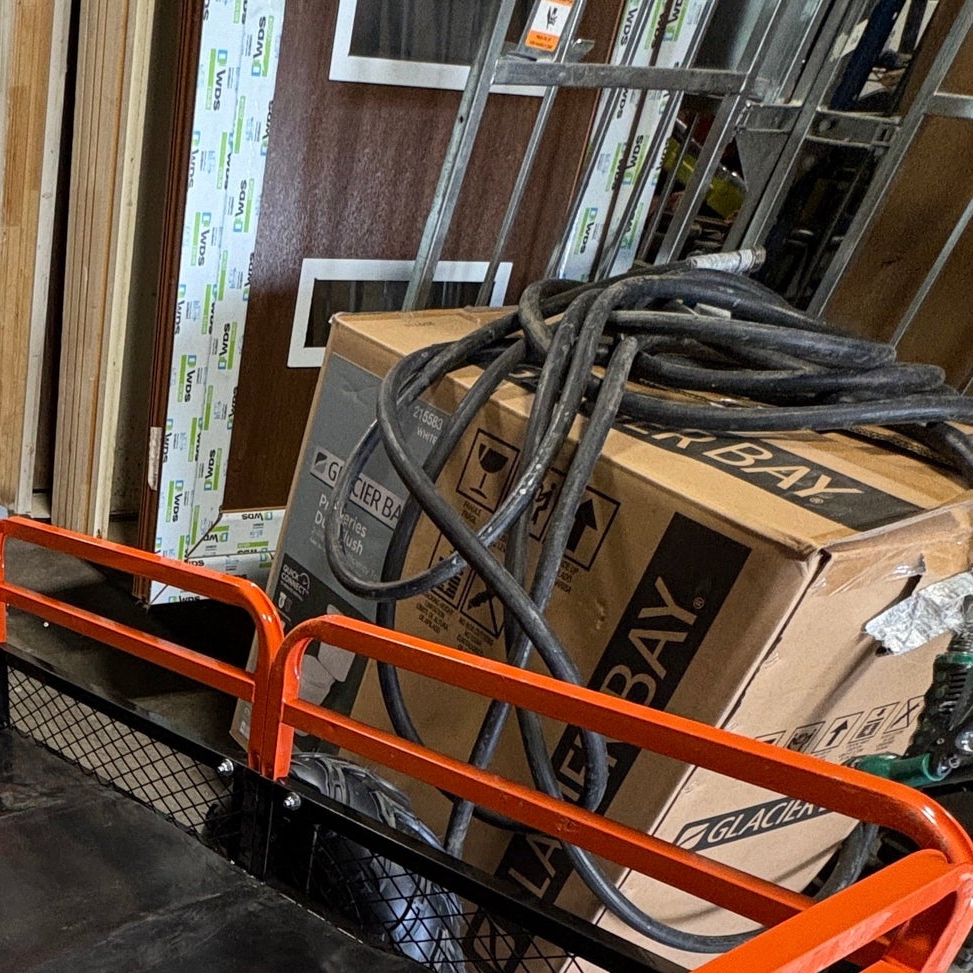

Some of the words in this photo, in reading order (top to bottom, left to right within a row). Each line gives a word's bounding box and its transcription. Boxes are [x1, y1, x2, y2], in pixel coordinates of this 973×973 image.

[253, 16, 266, 58] WDS
[620, 8, 638, 46] WDS
[213, 69, 226, 111] WDS
[235, 179, 247, 217] WDS
[198, 229, 210, 267] WDS
[580, 222, 595, 253] WDS
[219, 323, 230, 356] WDS
[184, 370, 195, 402] WDS
[413, 406, 444, 430] 215583
[204, 449, 215, 479] WDS
[702, 442, 865, 498] BAY
[172, 493, 183, 522] WDS
[328, 462, 382, 511] GCIER
[382, 496, 402, 521] BA
[241, 512, 263, 521] WDS
[281, 573, 306, 596] CONNECT
[283, 564, 298, 580] QUICK
[600, 576, 697, 705] BAY
